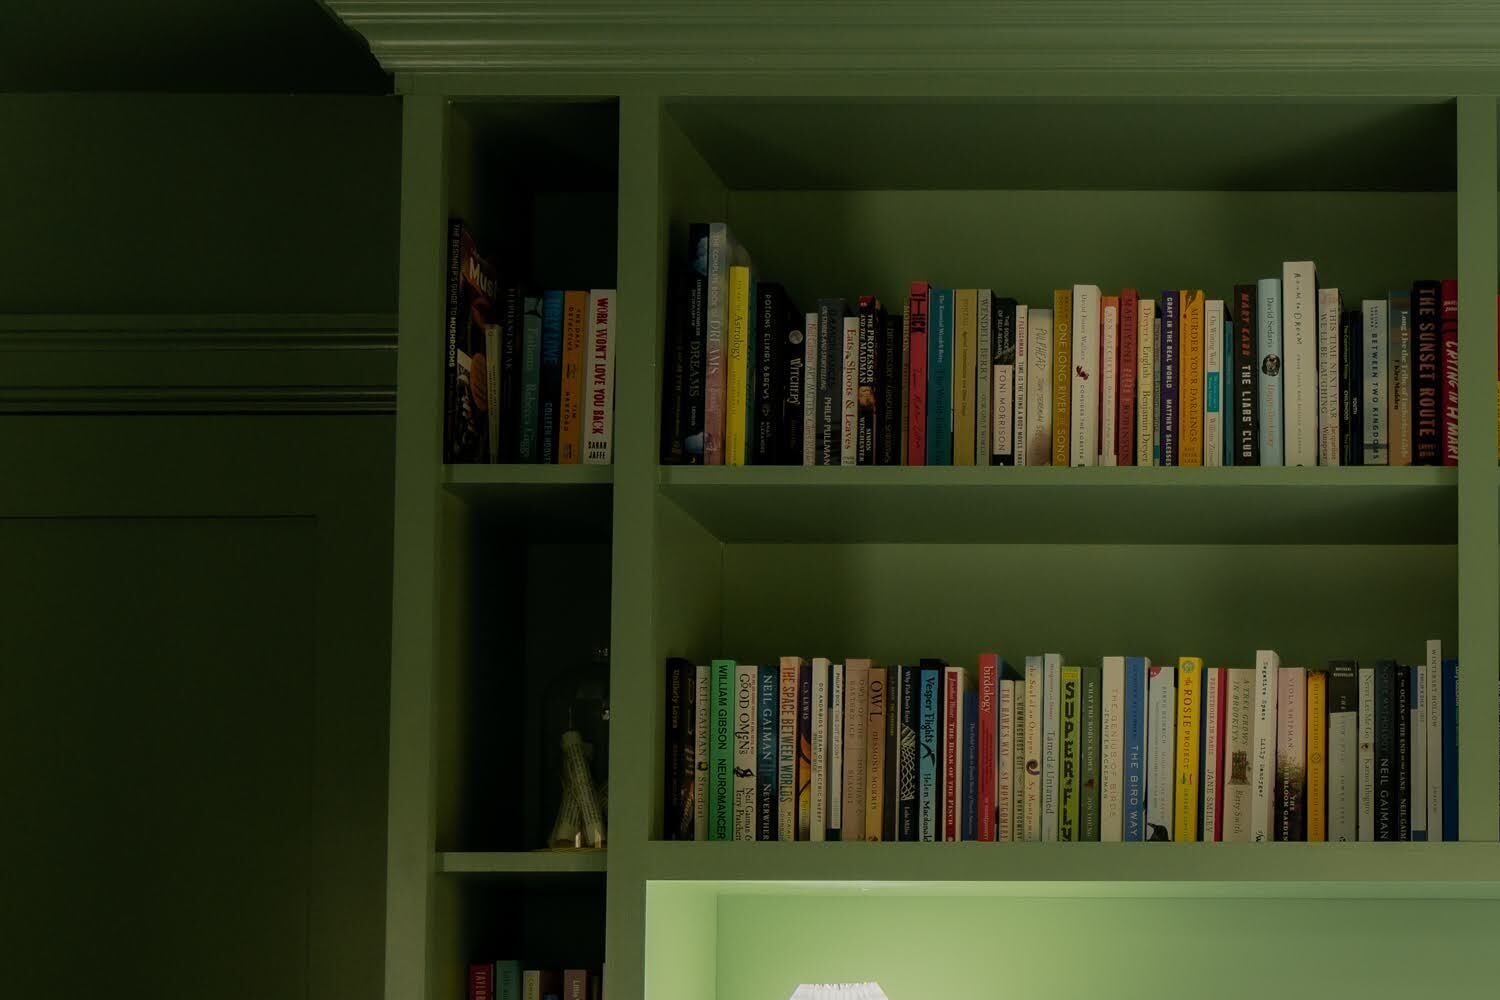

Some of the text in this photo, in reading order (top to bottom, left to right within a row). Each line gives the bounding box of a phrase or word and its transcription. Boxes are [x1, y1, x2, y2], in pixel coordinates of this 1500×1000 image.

[1190, 308, 1198, 352] MURDER
[1266, 298, 1274, 318] David
[732, 313, 743, 360] Astrology
[866, 330, 874, 383] PROFESSOR
[1419, 289, 1435, 437] THE SUNSET ROUTE
[592, 298, 608, 434] WORK WON'T LOVE YOU BACK
[689, 341, 700, 397] DREAMS
[1190, 356, 1198, 384] YOUR
[998, 398, 1006, 451] MORRISON
[1056, 430, 1065, 461] SONG
[981, 666, 994, 714] birdology
[1233, 681, 1240, 692] IN
[762, 675, 772, 760] NEIL GAIMAN
[780, 667, 794, 802] THE SPACE BETWEEN WORLDS
[717, 665, 727, 839] WILLIAM GIBSON NEUROMANCER
[1130, 811, 1138, 836] WAY
[1380, 759, 1390, 838] NEIL GAIMAN
